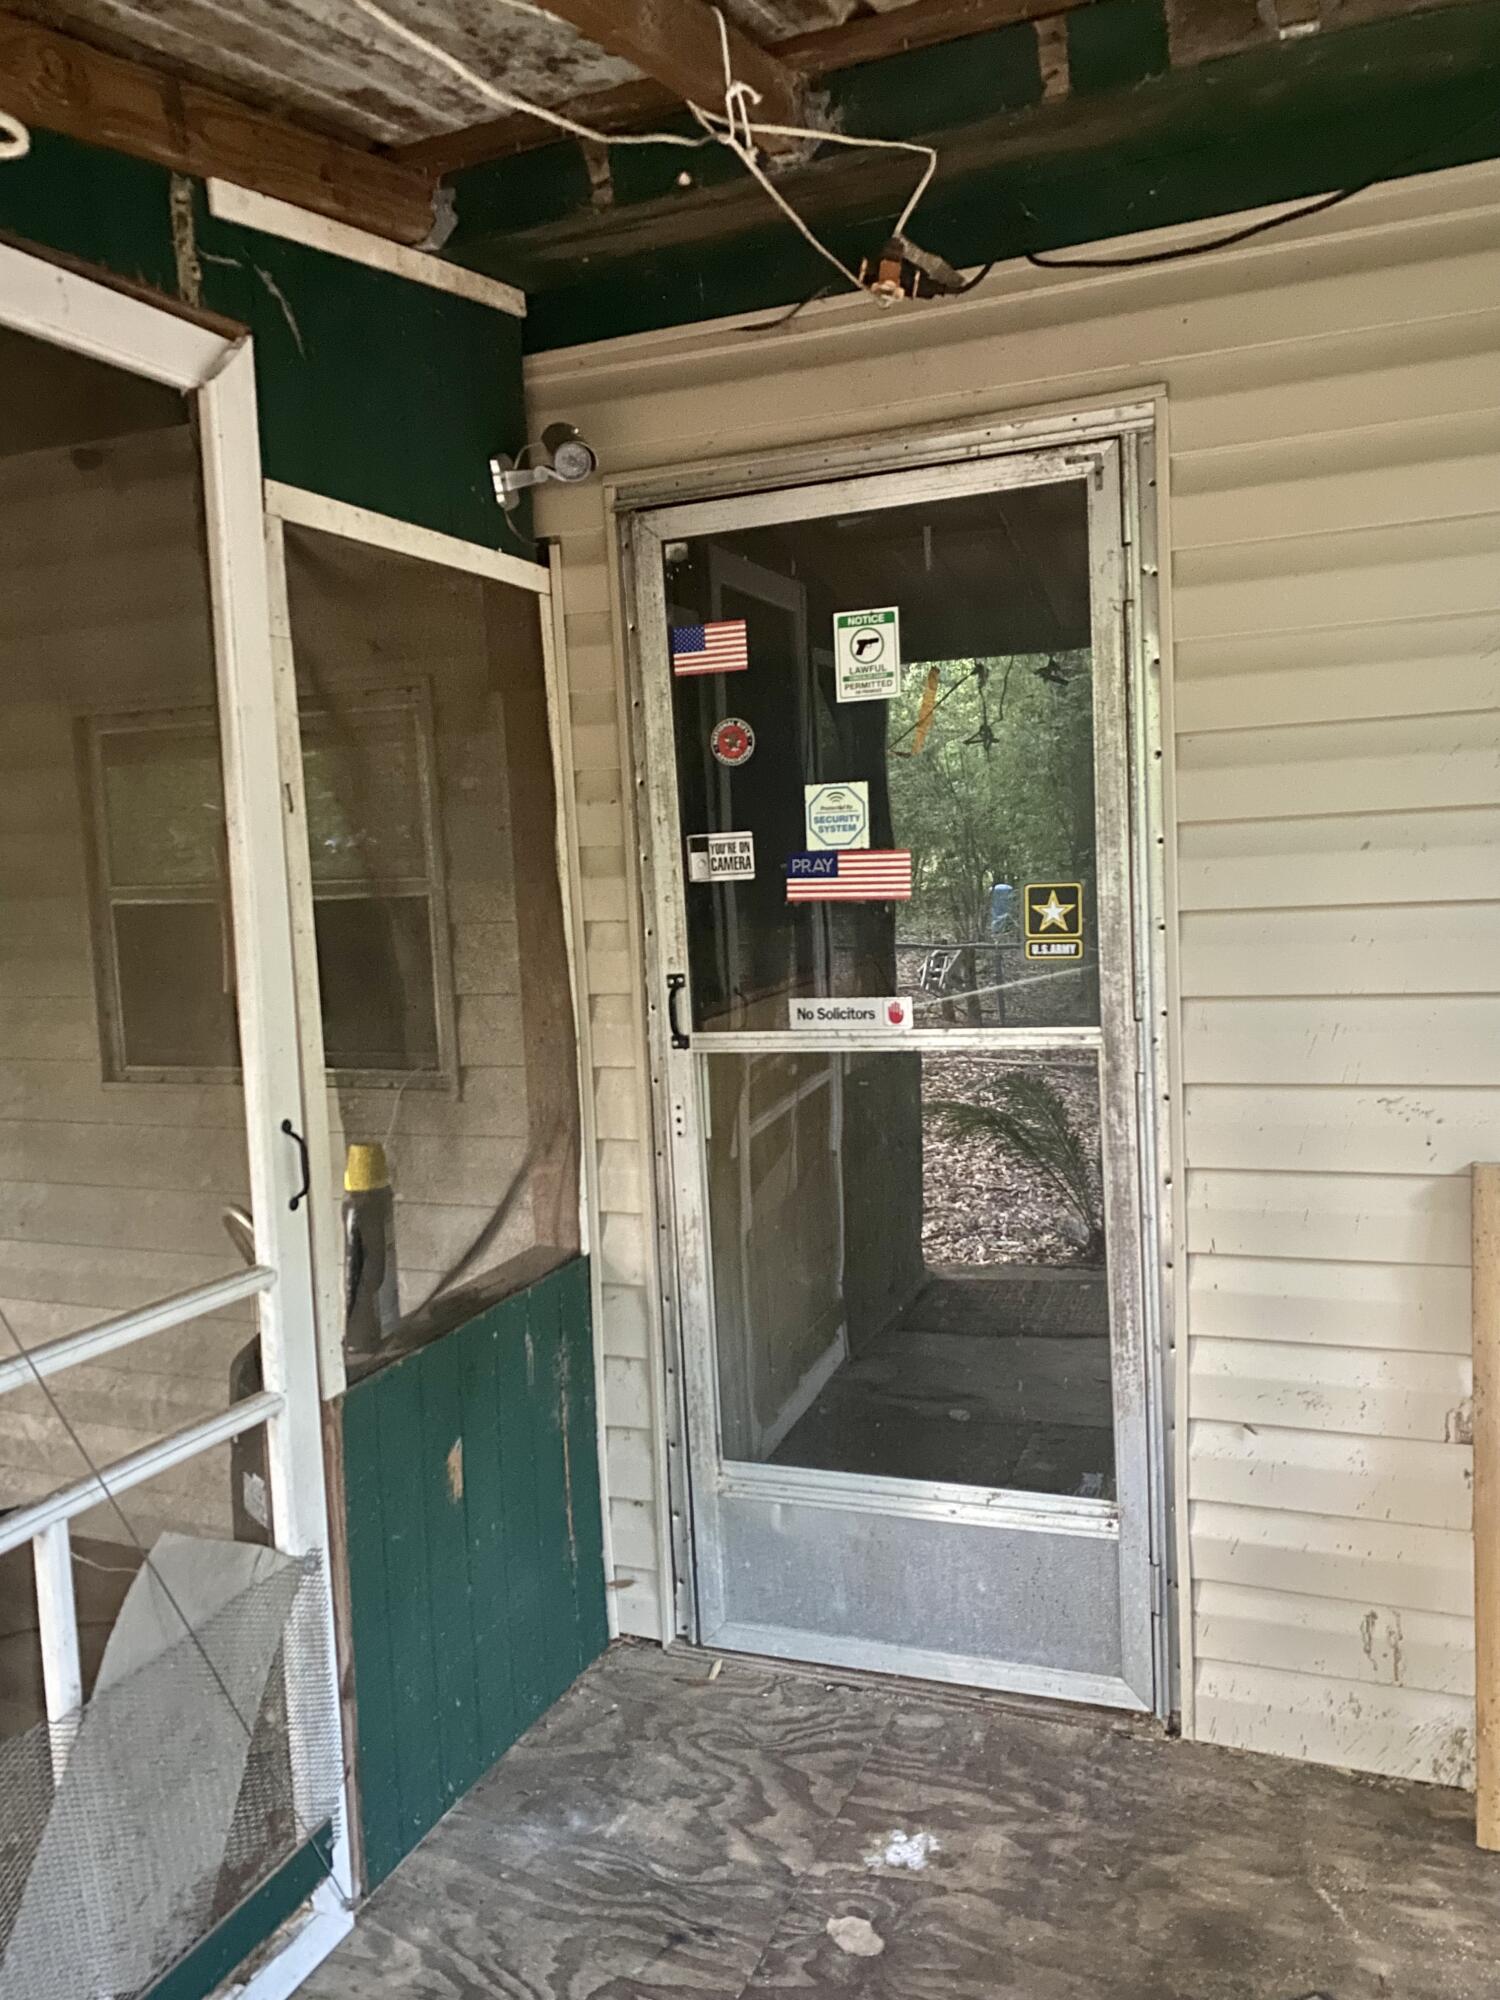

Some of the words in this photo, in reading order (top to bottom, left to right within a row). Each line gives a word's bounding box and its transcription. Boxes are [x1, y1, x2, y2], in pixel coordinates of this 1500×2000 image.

[847, 614, 885, 626] NOTICE
[849, 664, 886, 675] LAWFUL
[844, 680, 893, 690] PERMITTED
[813, 814, 860, 825] SECURITY
[818, 824, 857, 833] SYSTEM
[709, 842, 736, 855] YOU'RE
[739, 841, 750, 853] ON
[710, 855, 752, 872] CAMERA
[791, 858, 834, 873] PRAY
[796, 1007, 814, 1021] No
[816, 1006, 876, 1021] Solicitors
